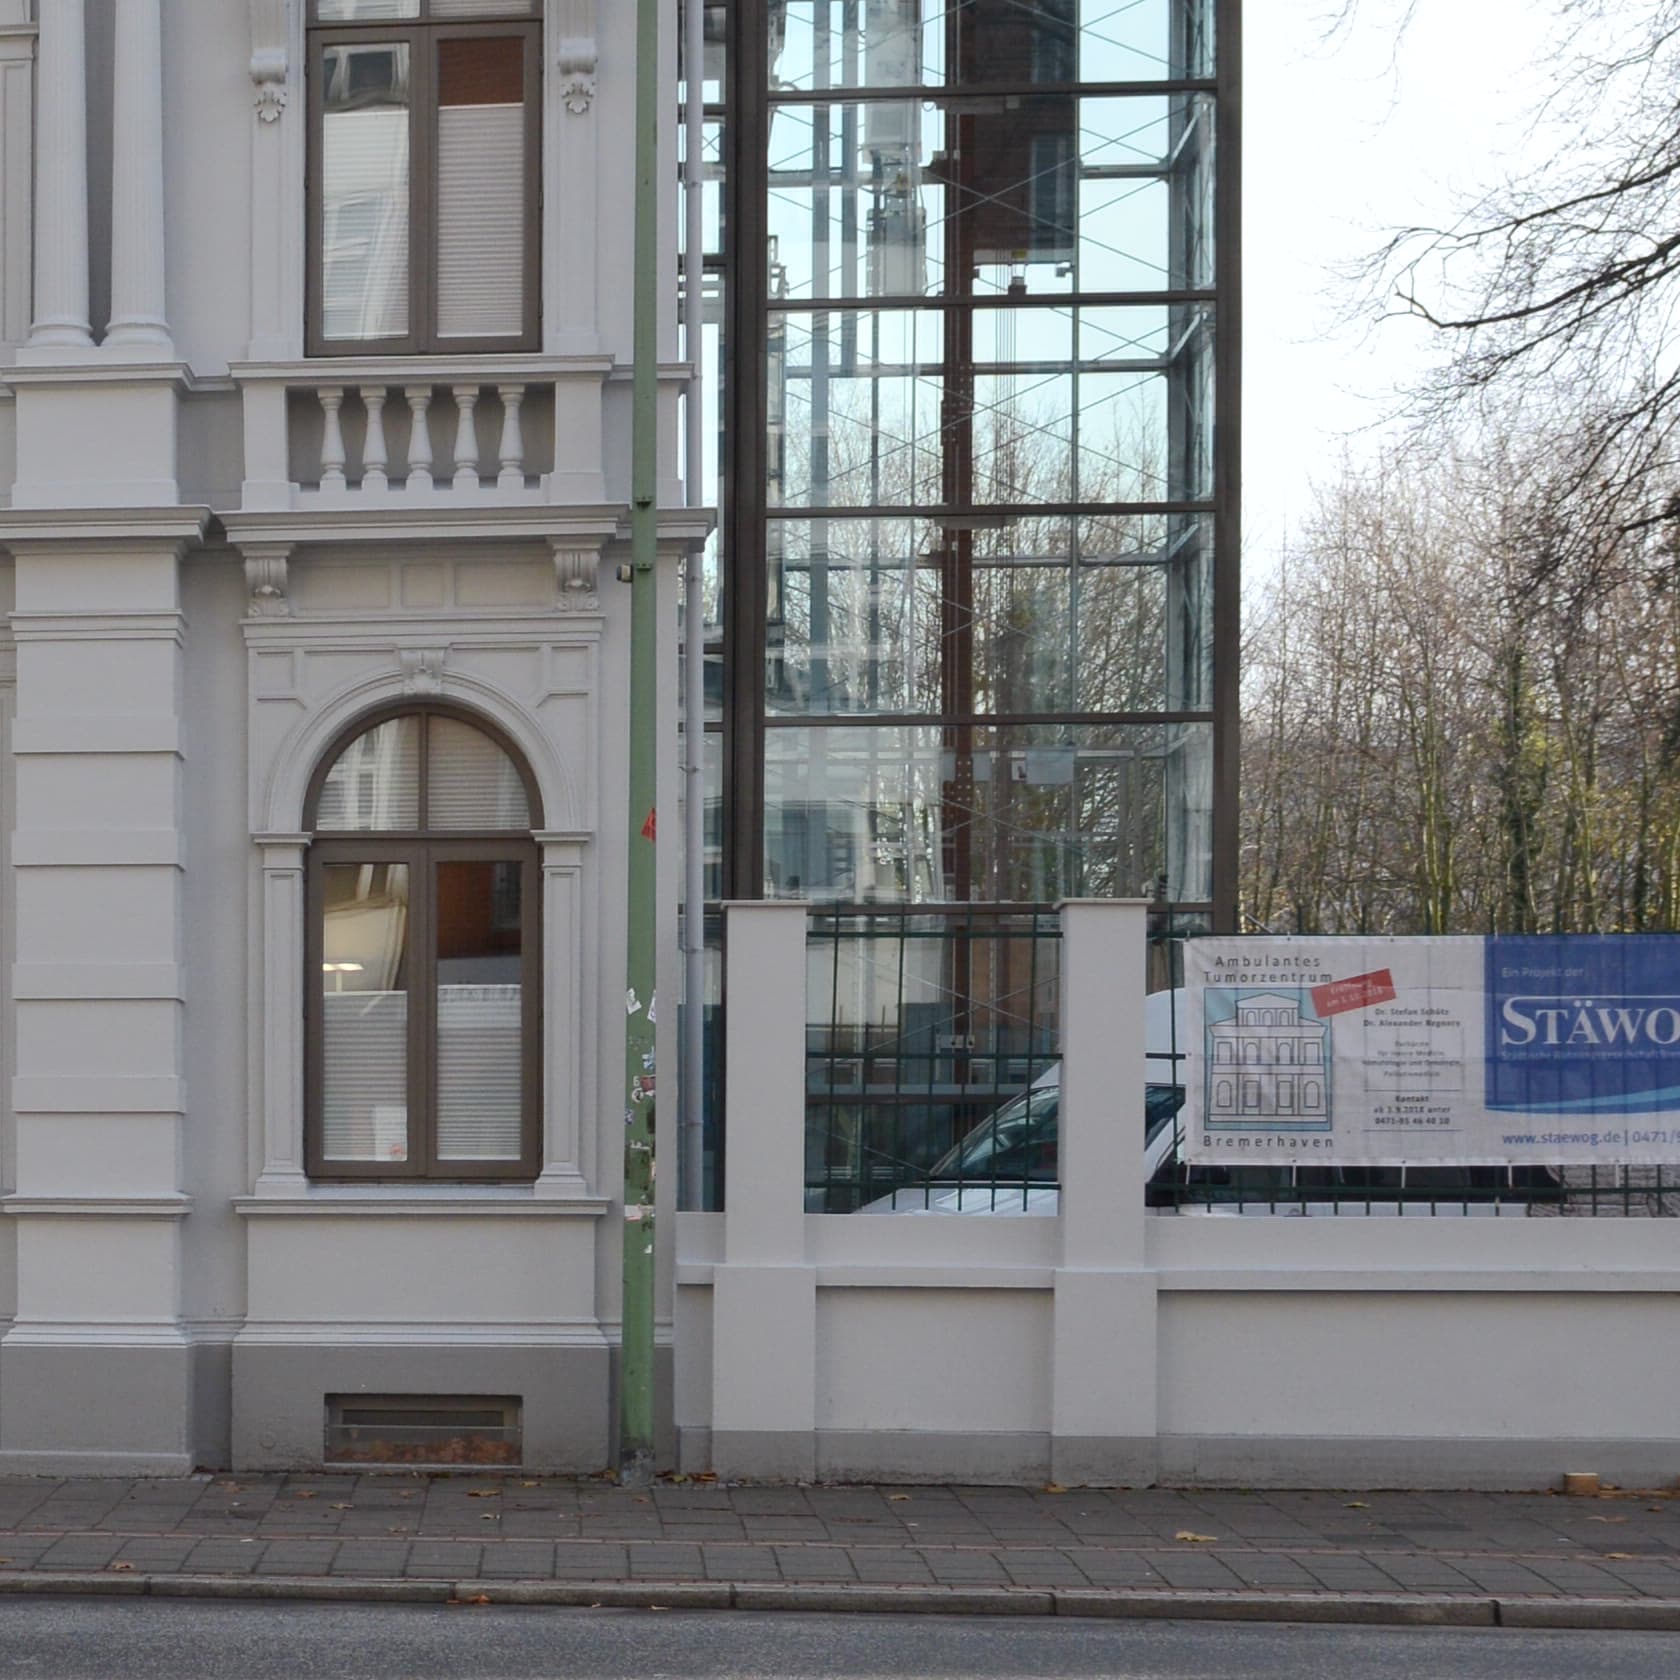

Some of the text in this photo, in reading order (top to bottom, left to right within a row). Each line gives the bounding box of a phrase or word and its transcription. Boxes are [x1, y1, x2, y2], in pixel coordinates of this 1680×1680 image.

[1215, 954, 1321, 968] Ambulantes
[1203, 970, 1333, 984] Tumorzentrum
[1395, 1094, 1430, 1103] Kontakt
[1203, 1134, 1334, 1148] Bremerhaven
[1502, 1130, 1620, 1146] www.staewog.de
